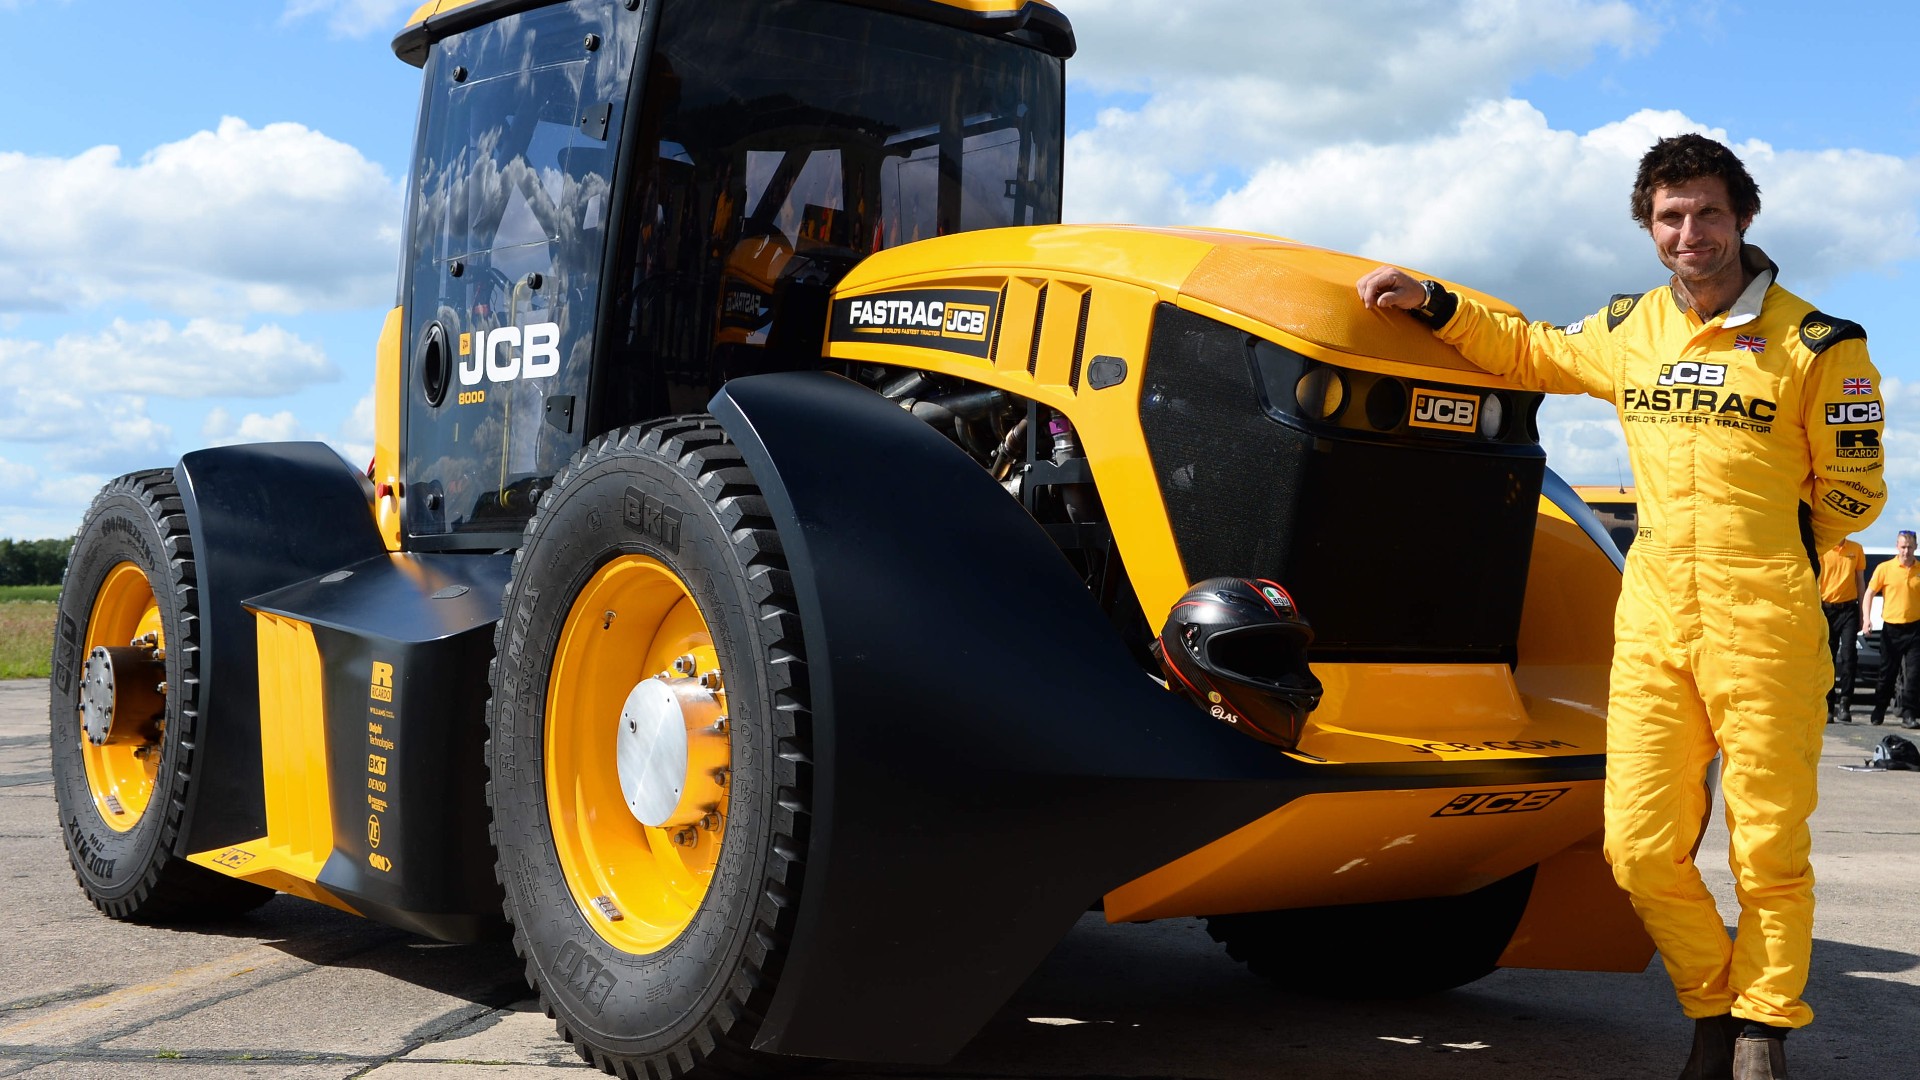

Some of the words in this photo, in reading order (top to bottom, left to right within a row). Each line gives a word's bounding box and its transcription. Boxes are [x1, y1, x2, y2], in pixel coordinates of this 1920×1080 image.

[849, 299, 945, 328] FASTRAC
[945, 310, 986, 334] JCB
[901, 327, 920, 336] FASTEST
[920, 329, 941, 337] TRACTOR
[459, 322, 561, 386] JCB
[1658, 361, 1727, 386] JCB
[458, 390, 485, 405] 8000
[1624, 388, 1777, 423] FASTRAC
[1416, 398, 1475, 425] JCB
[1826, 403, 1882, 424] JCB
[1714, 418, 1772, 434] TRACTOR
[1840, 429, 1880, 448] R
[1838, 449, 1879, 458] RICARDO
[1825, 465, 1867, 473] WILLIAMS
[1826, 490, 1869, 514] BKT
[625, 490, 681, 551] BKT
[508, 573, 541, 671] MAX
[372, 661, 393, 688] R
[521, 653, 535, 690] 696
[371, 686, 391, 701] RICARDO
[369, 722, 383, 735] Delphi
[500, 668, 519, 782] RIDE
[369, 734, 395, 751] Technologies
[1406, 739, 1581, 754] JCB.COM
[368, 756, 387, 774] BKT
[367, 778, 387, 793] DENSO
[1438, 789, 1564, 816] JCB
[68, 815, 93, 862] MAX
[88, 852, 117, 880] RIDE
[214, 848, 253, 869] JCB
[553, 943, 617, 1014] BKT
